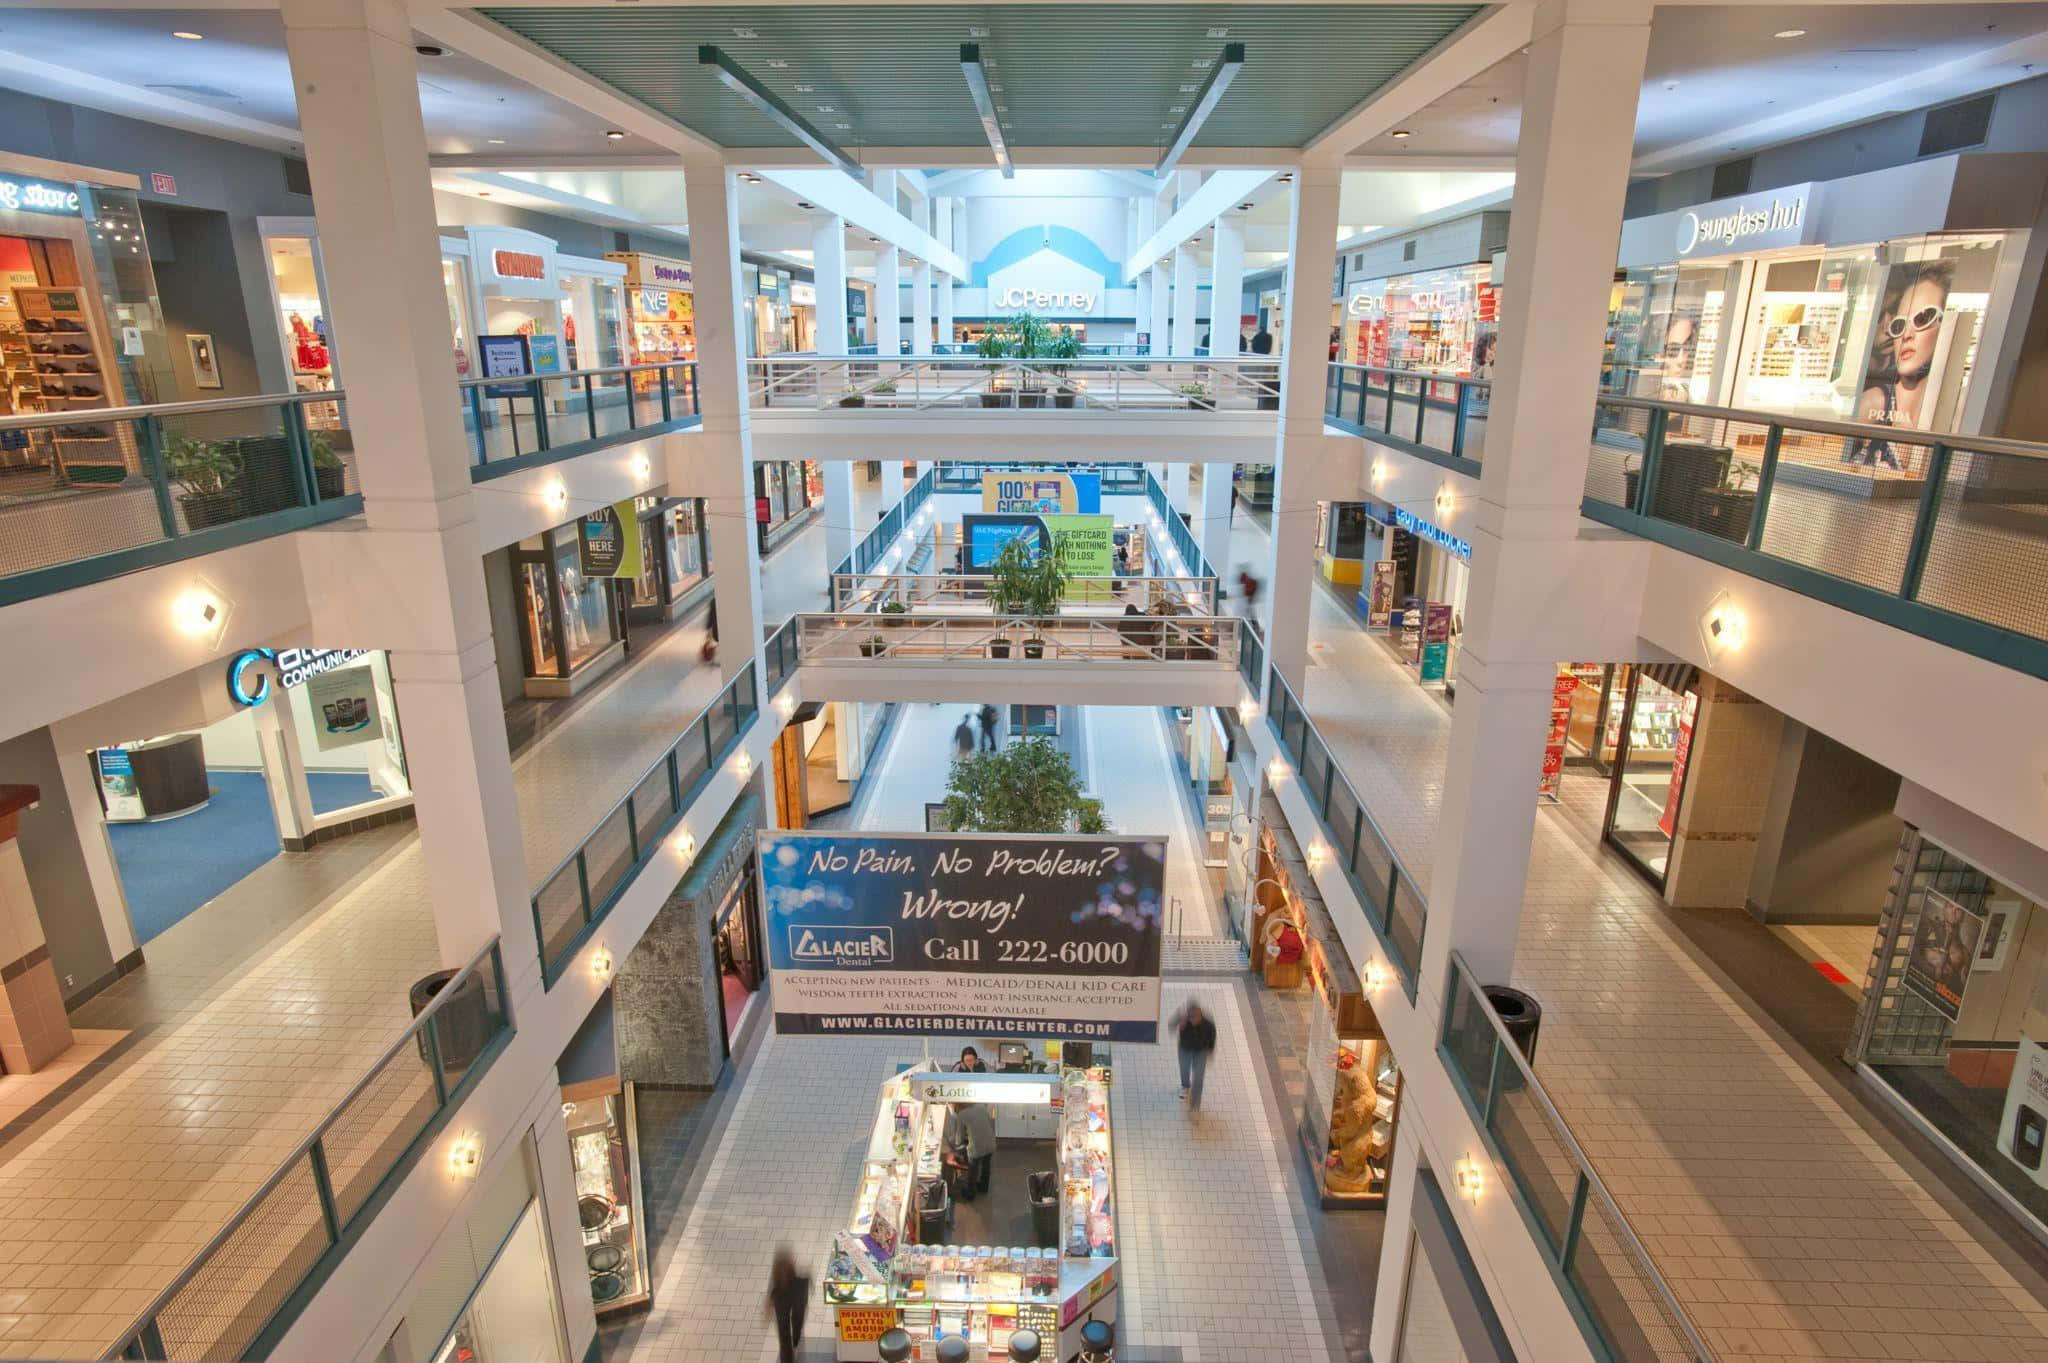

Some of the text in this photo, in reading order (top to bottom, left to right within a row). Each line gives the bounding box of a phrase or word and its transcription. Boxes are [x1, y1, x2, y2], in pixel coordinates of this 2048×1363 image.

[23, 184, 79, 210] store
[1699, 198, 1805, 246] sunglass hut
[995, 287, 1097, 313] JCPenney
[1867, 409, 1912, 424] PRADA
[1075, 541, 1107, 550] NOTHING
[1077, 551, 1095, 560] LOSE
[808, 846, 1120, 877] No Pain. No Problem?
[902, 888, 1025, 933] Wrong!
[795, 929, 889, 957] GLACIER
[924, 937, 1128, 964] Call 222-6000
[836, 957, 871, 967] Dental
[784, 976, 847, 986] ACCEPTING
[850, 977, 876, 986] NEW
[879, 977, 931, 987] PATIENTS
[1081, 981, 1107, 991] KID
[1111, 982, 1148, 993] CARE
[799, 990, 1134, 1005] WISDOM TEETH EXTRACTION MOST INSURANCE ACCEPTED
[882, 1003, 1048, 1016] ALL SEDATIONS ARE AVAILABLE
[821, 1016, 1111, 1036] WWW.GLACIERDENTALCENTER.COM
